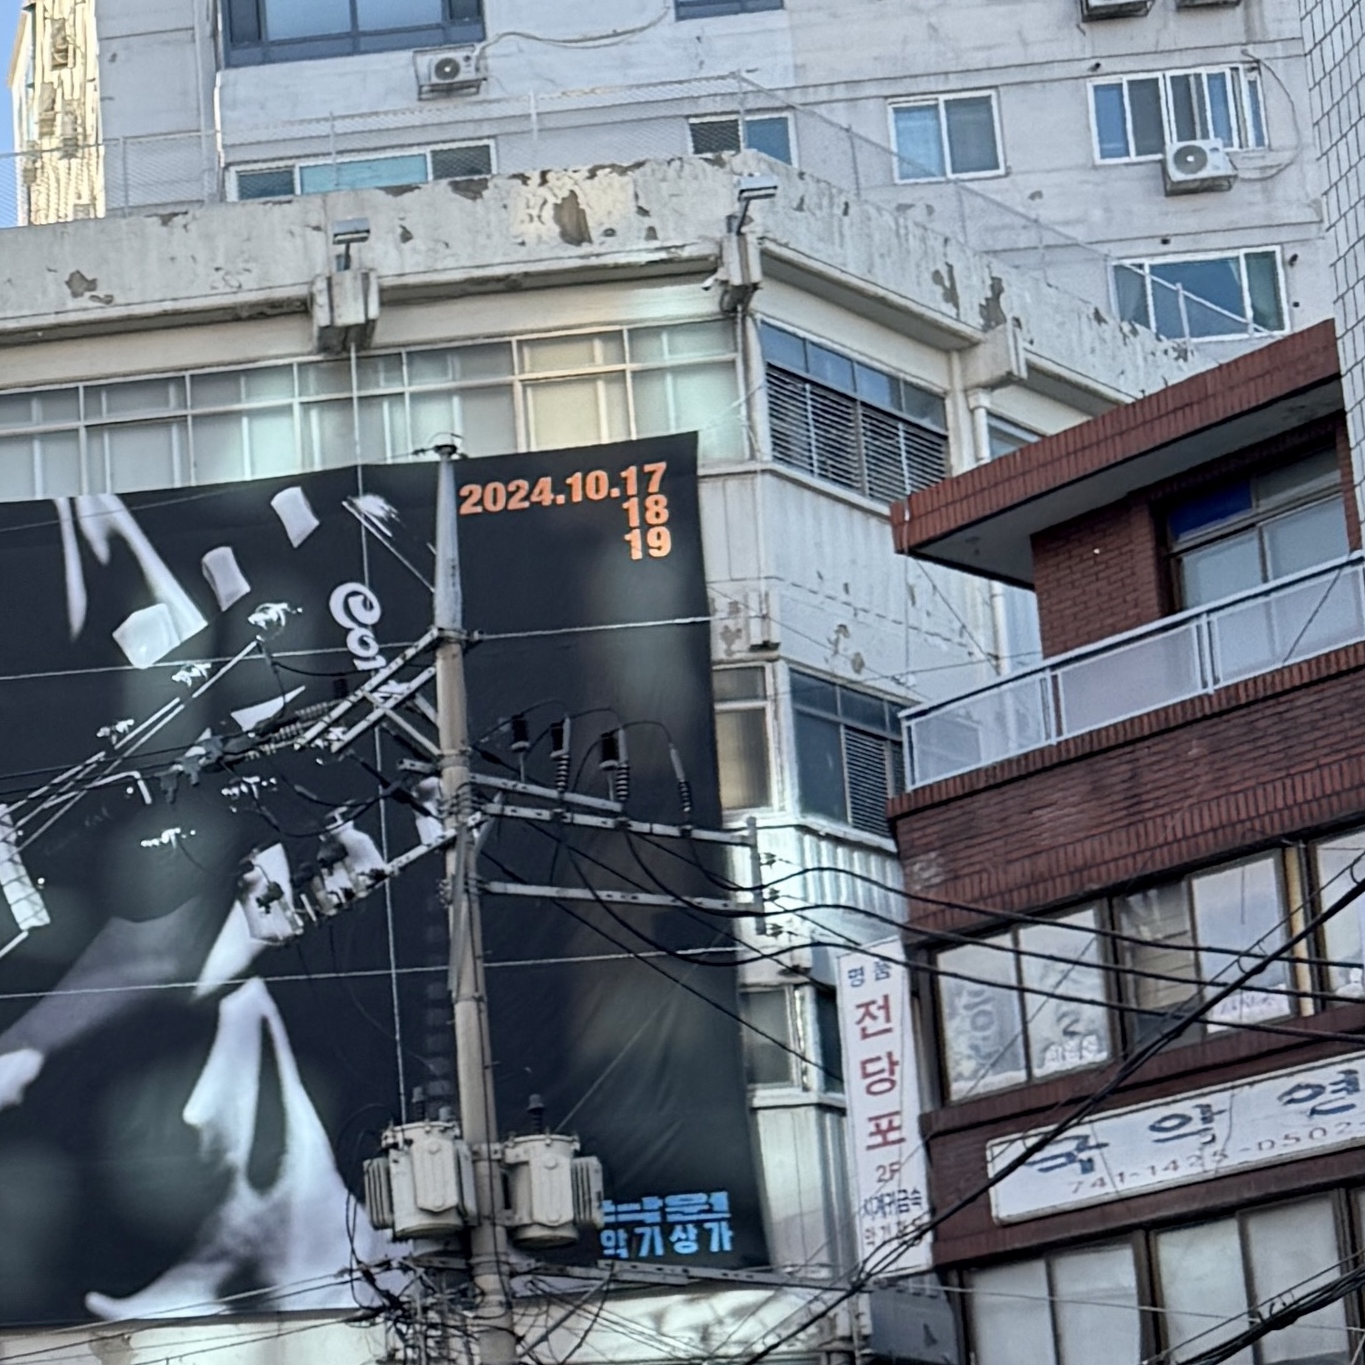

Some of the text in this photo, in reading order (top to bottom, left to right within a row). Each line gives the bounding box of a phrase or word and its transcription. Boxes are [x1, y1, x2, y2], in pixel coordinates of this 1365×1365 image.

[459, 461, 667, 515] 2024.10.17
[623, 494, 670, 527] 18
[624, 526, 672, 560] 19
[854, 995, 906, 1151] 전당포
[600, 1220, 733, 1259] 악기상가
